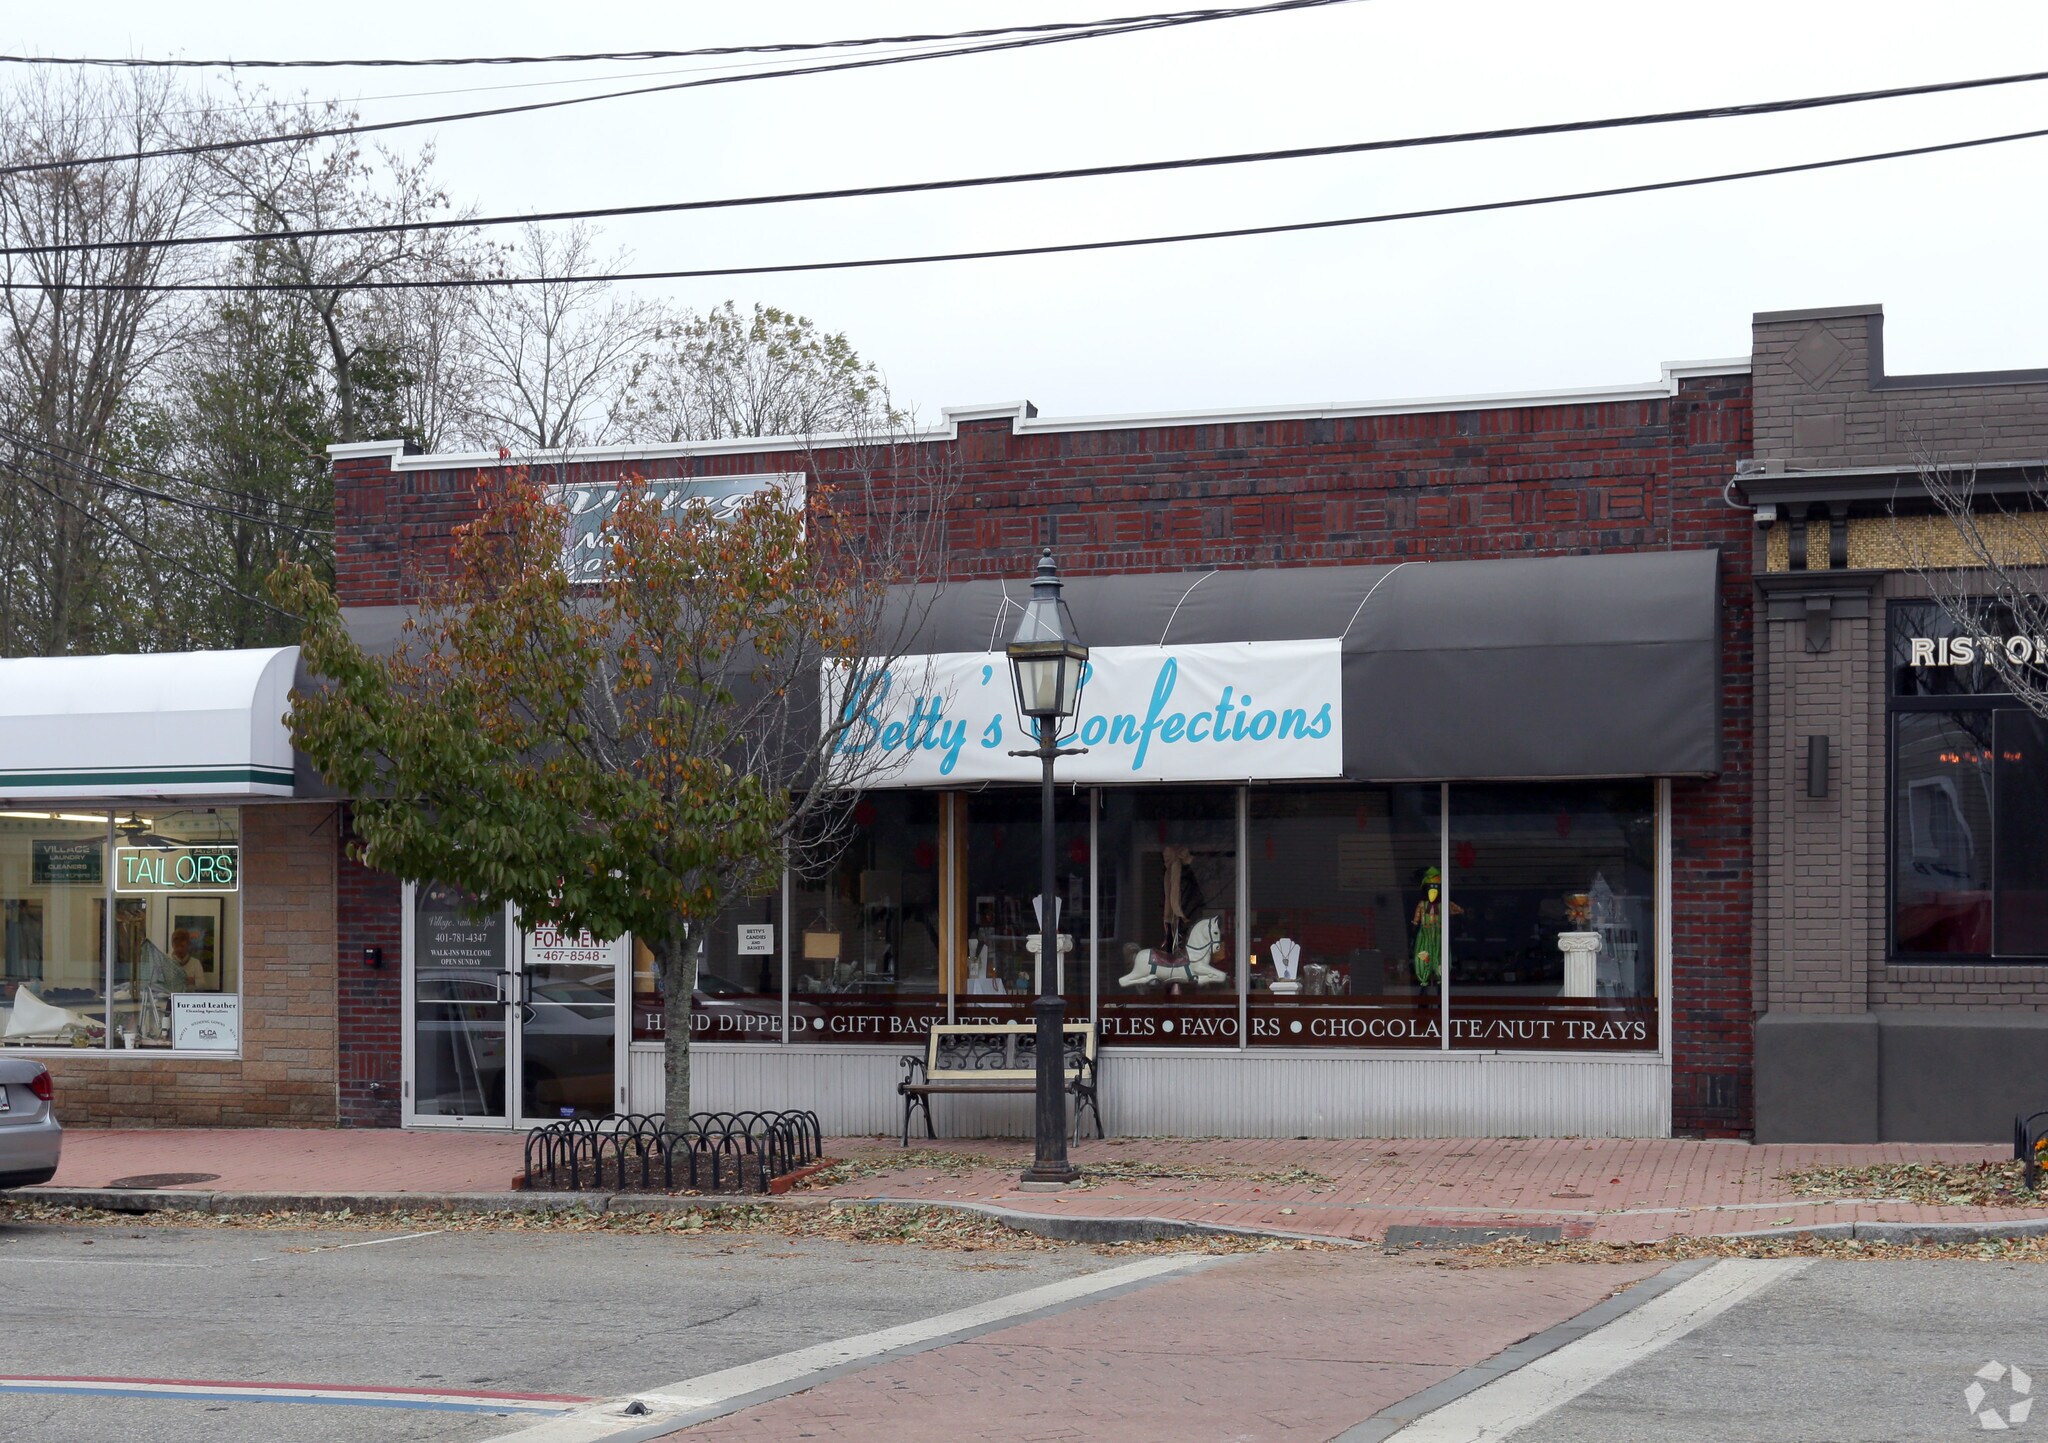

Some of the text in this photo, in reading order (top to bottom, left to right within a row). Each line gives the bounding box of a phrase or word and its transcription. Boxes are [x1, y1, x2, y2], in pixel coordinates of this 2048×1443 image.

[832, 663, 1003, 776] Betty's
[122, 855, 233, 885] TAILORS
[435, 932, 487, 943] 401-781-4347
[534, 931, 564, 947] FOR
[430, 949, 492, 957] WALK-INS WELCOME
[543, 950, 600, 961] 467-8548
[440, 958, 482, 966] OPEN SUNDAY
[645, 1013, 711, 1031] HD
[718, 1014, 808, 1032] DIPPED
[830, 1015, 885, 1033] GIFT
[1180, 1017, 1282, 1036] FAVORS
[1310, 1018, 1555, 1040] CHOCOLATE/NUT
[1562, 1020, 1647, 1041] TRAYS
